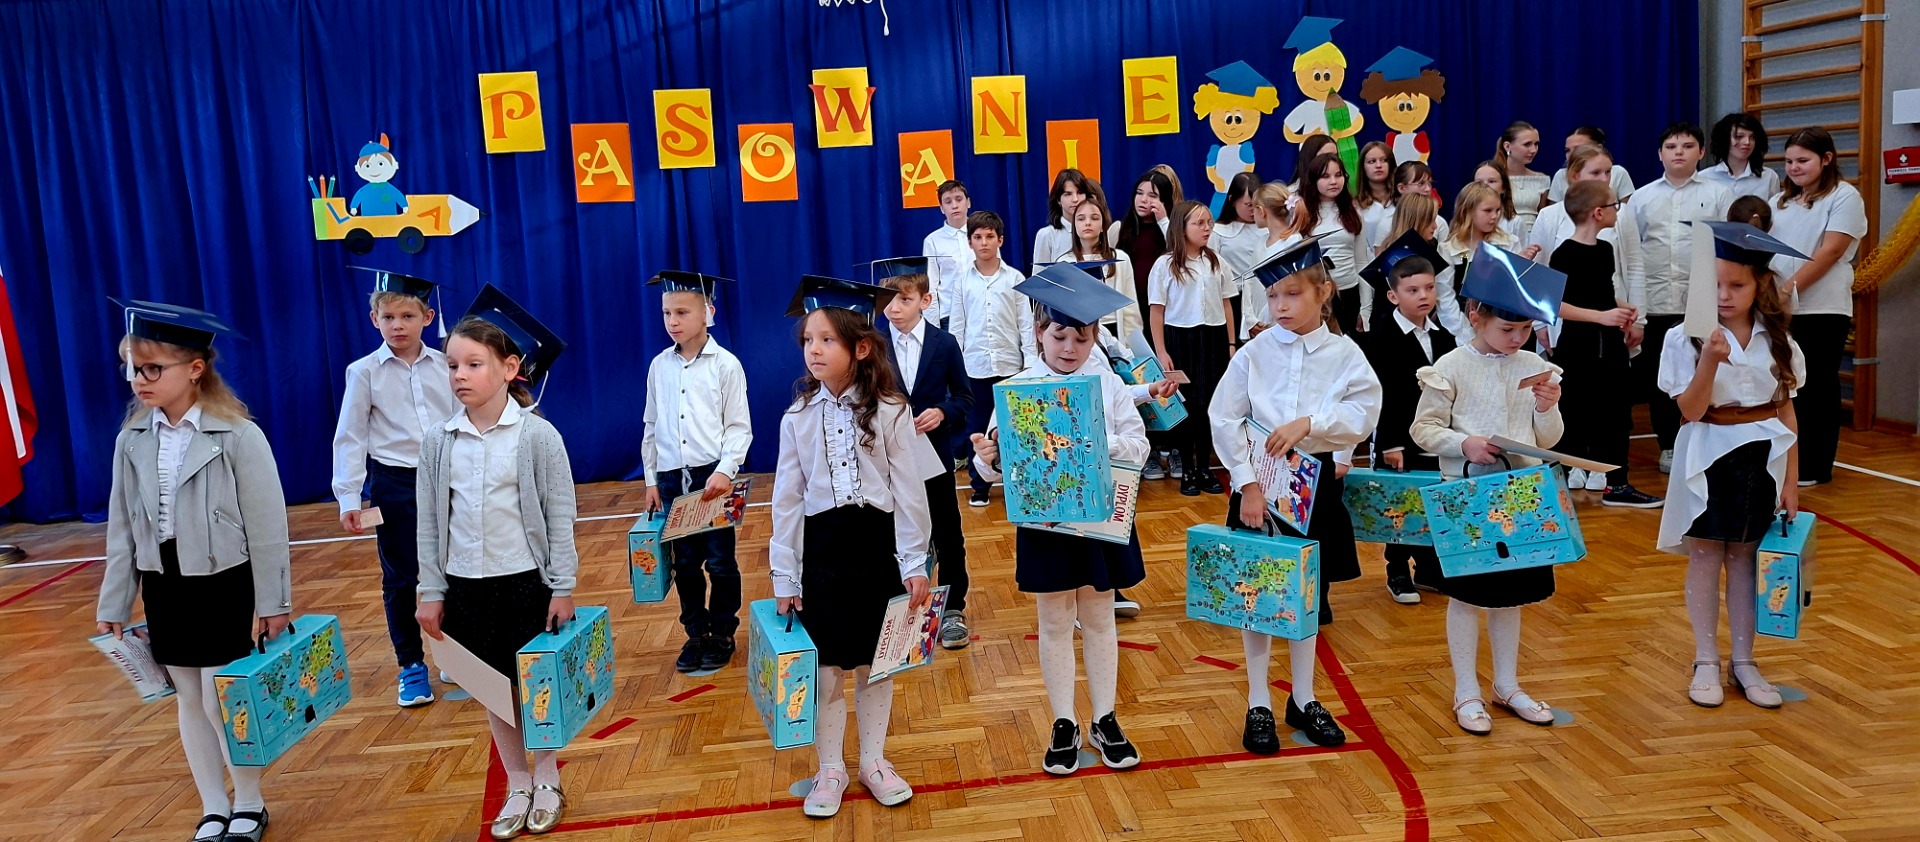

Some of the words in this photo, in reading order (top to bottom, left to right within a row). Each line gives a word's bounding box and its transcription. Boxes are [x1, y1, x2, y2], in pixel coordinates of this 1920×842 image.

[483, 74, 1171, 197] PASOWANIE
[417, 205, 441, 232] A
[1112, 483, 1130, 523] DYPLOM
[877, 618, 894, 660] DYPLOM
